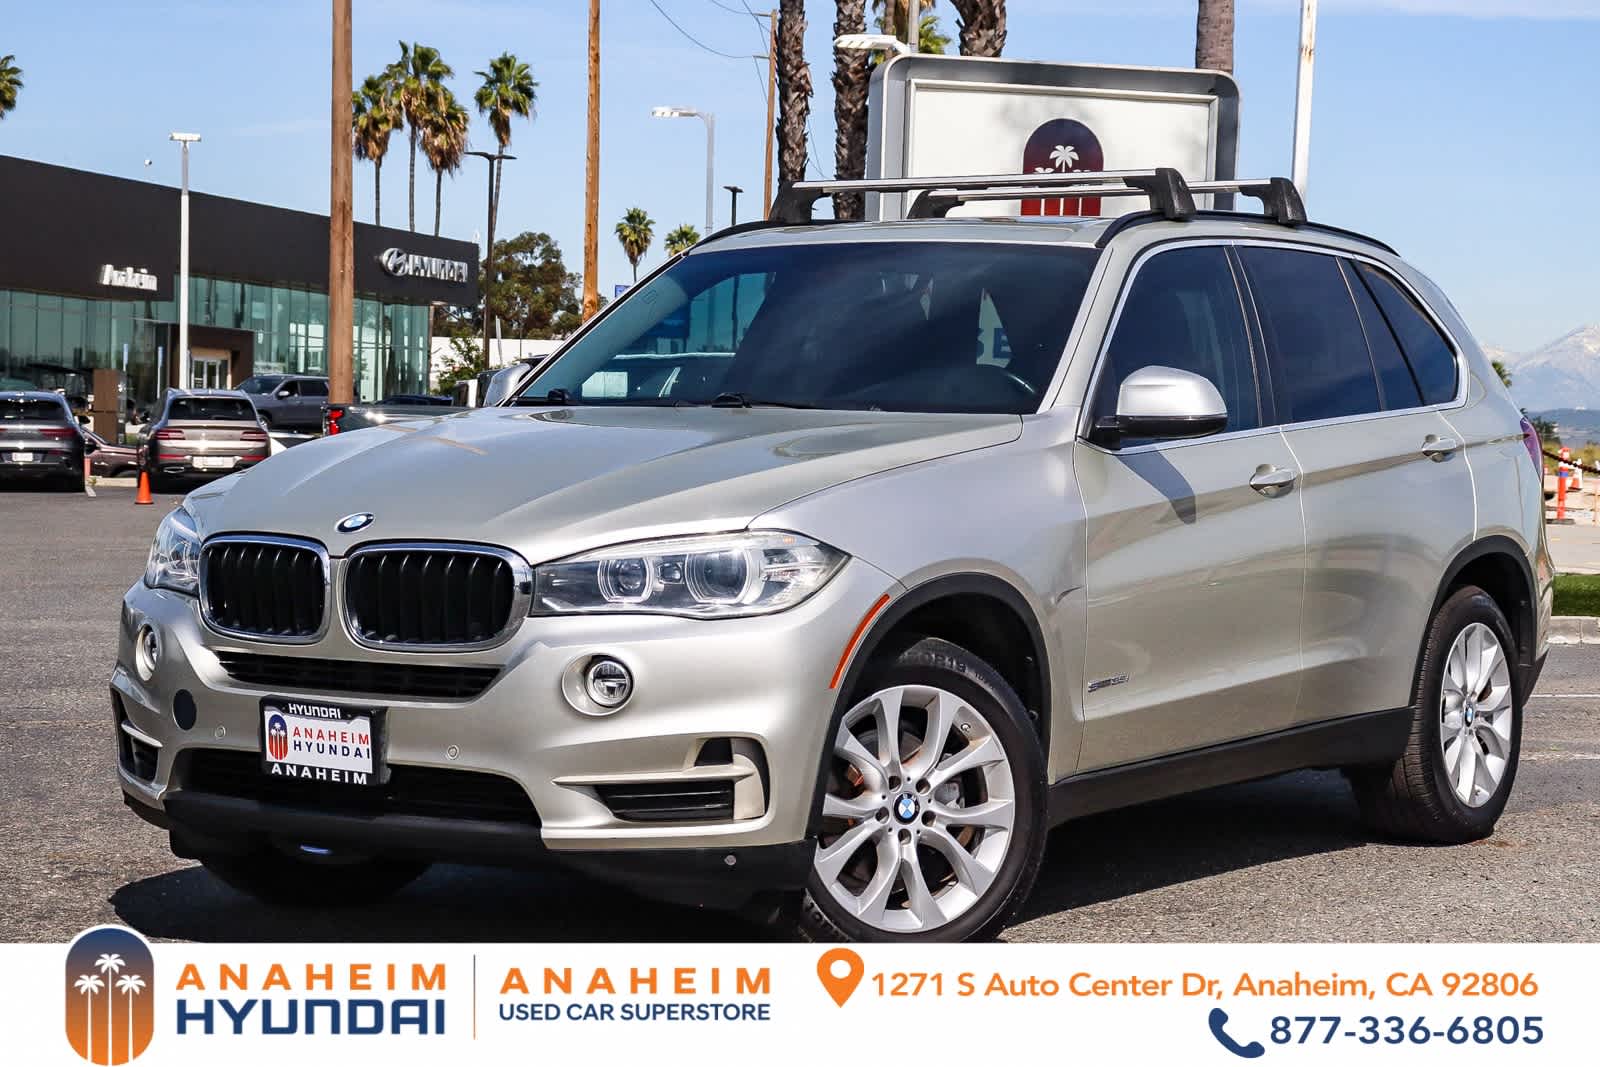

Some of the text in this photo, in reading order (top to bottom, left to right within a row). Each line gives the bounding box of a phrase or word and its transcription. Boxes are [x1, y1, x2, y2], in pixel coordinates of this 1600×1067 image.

[288, 703, 341, 719] HYUNDAI
[292, 726, 369, 745] ANAHEIM
[293, 740, 370, 759] HYUNDAI
[271, 763, 368, 785] ANAHEIM
